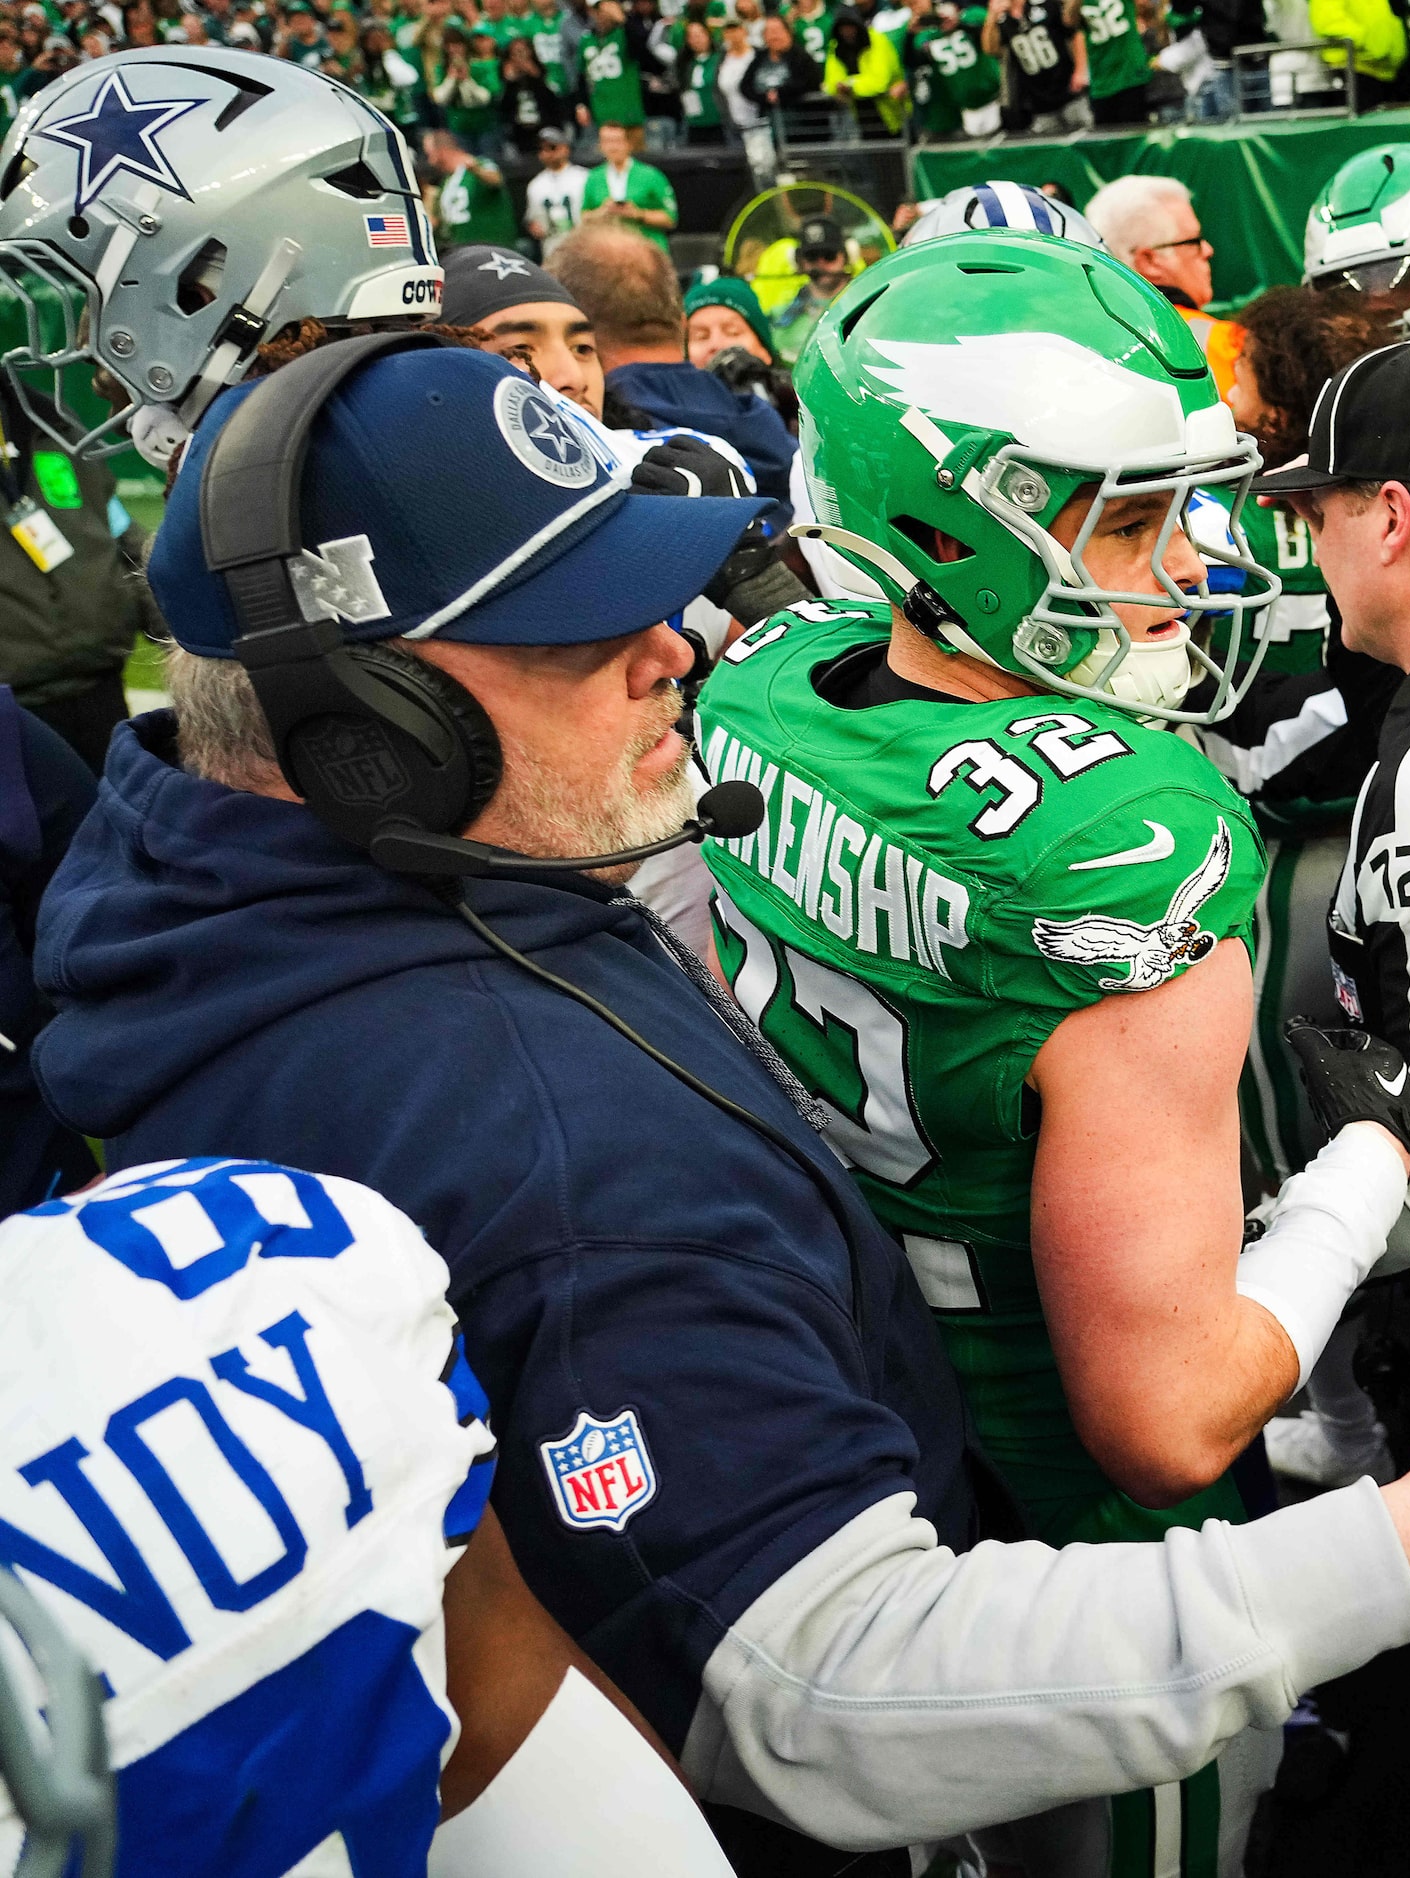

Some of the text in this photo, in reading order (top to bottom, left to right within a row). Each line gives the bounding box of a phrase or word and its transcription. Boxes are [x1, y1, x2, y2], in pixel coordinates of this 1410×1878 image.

[507, 392, 522, 431] DALLAS
[545, 459, 581, 477] DALLAS
[925, 713, 1137, 842] 32
[566, 1456, 644, 1513] NFL
